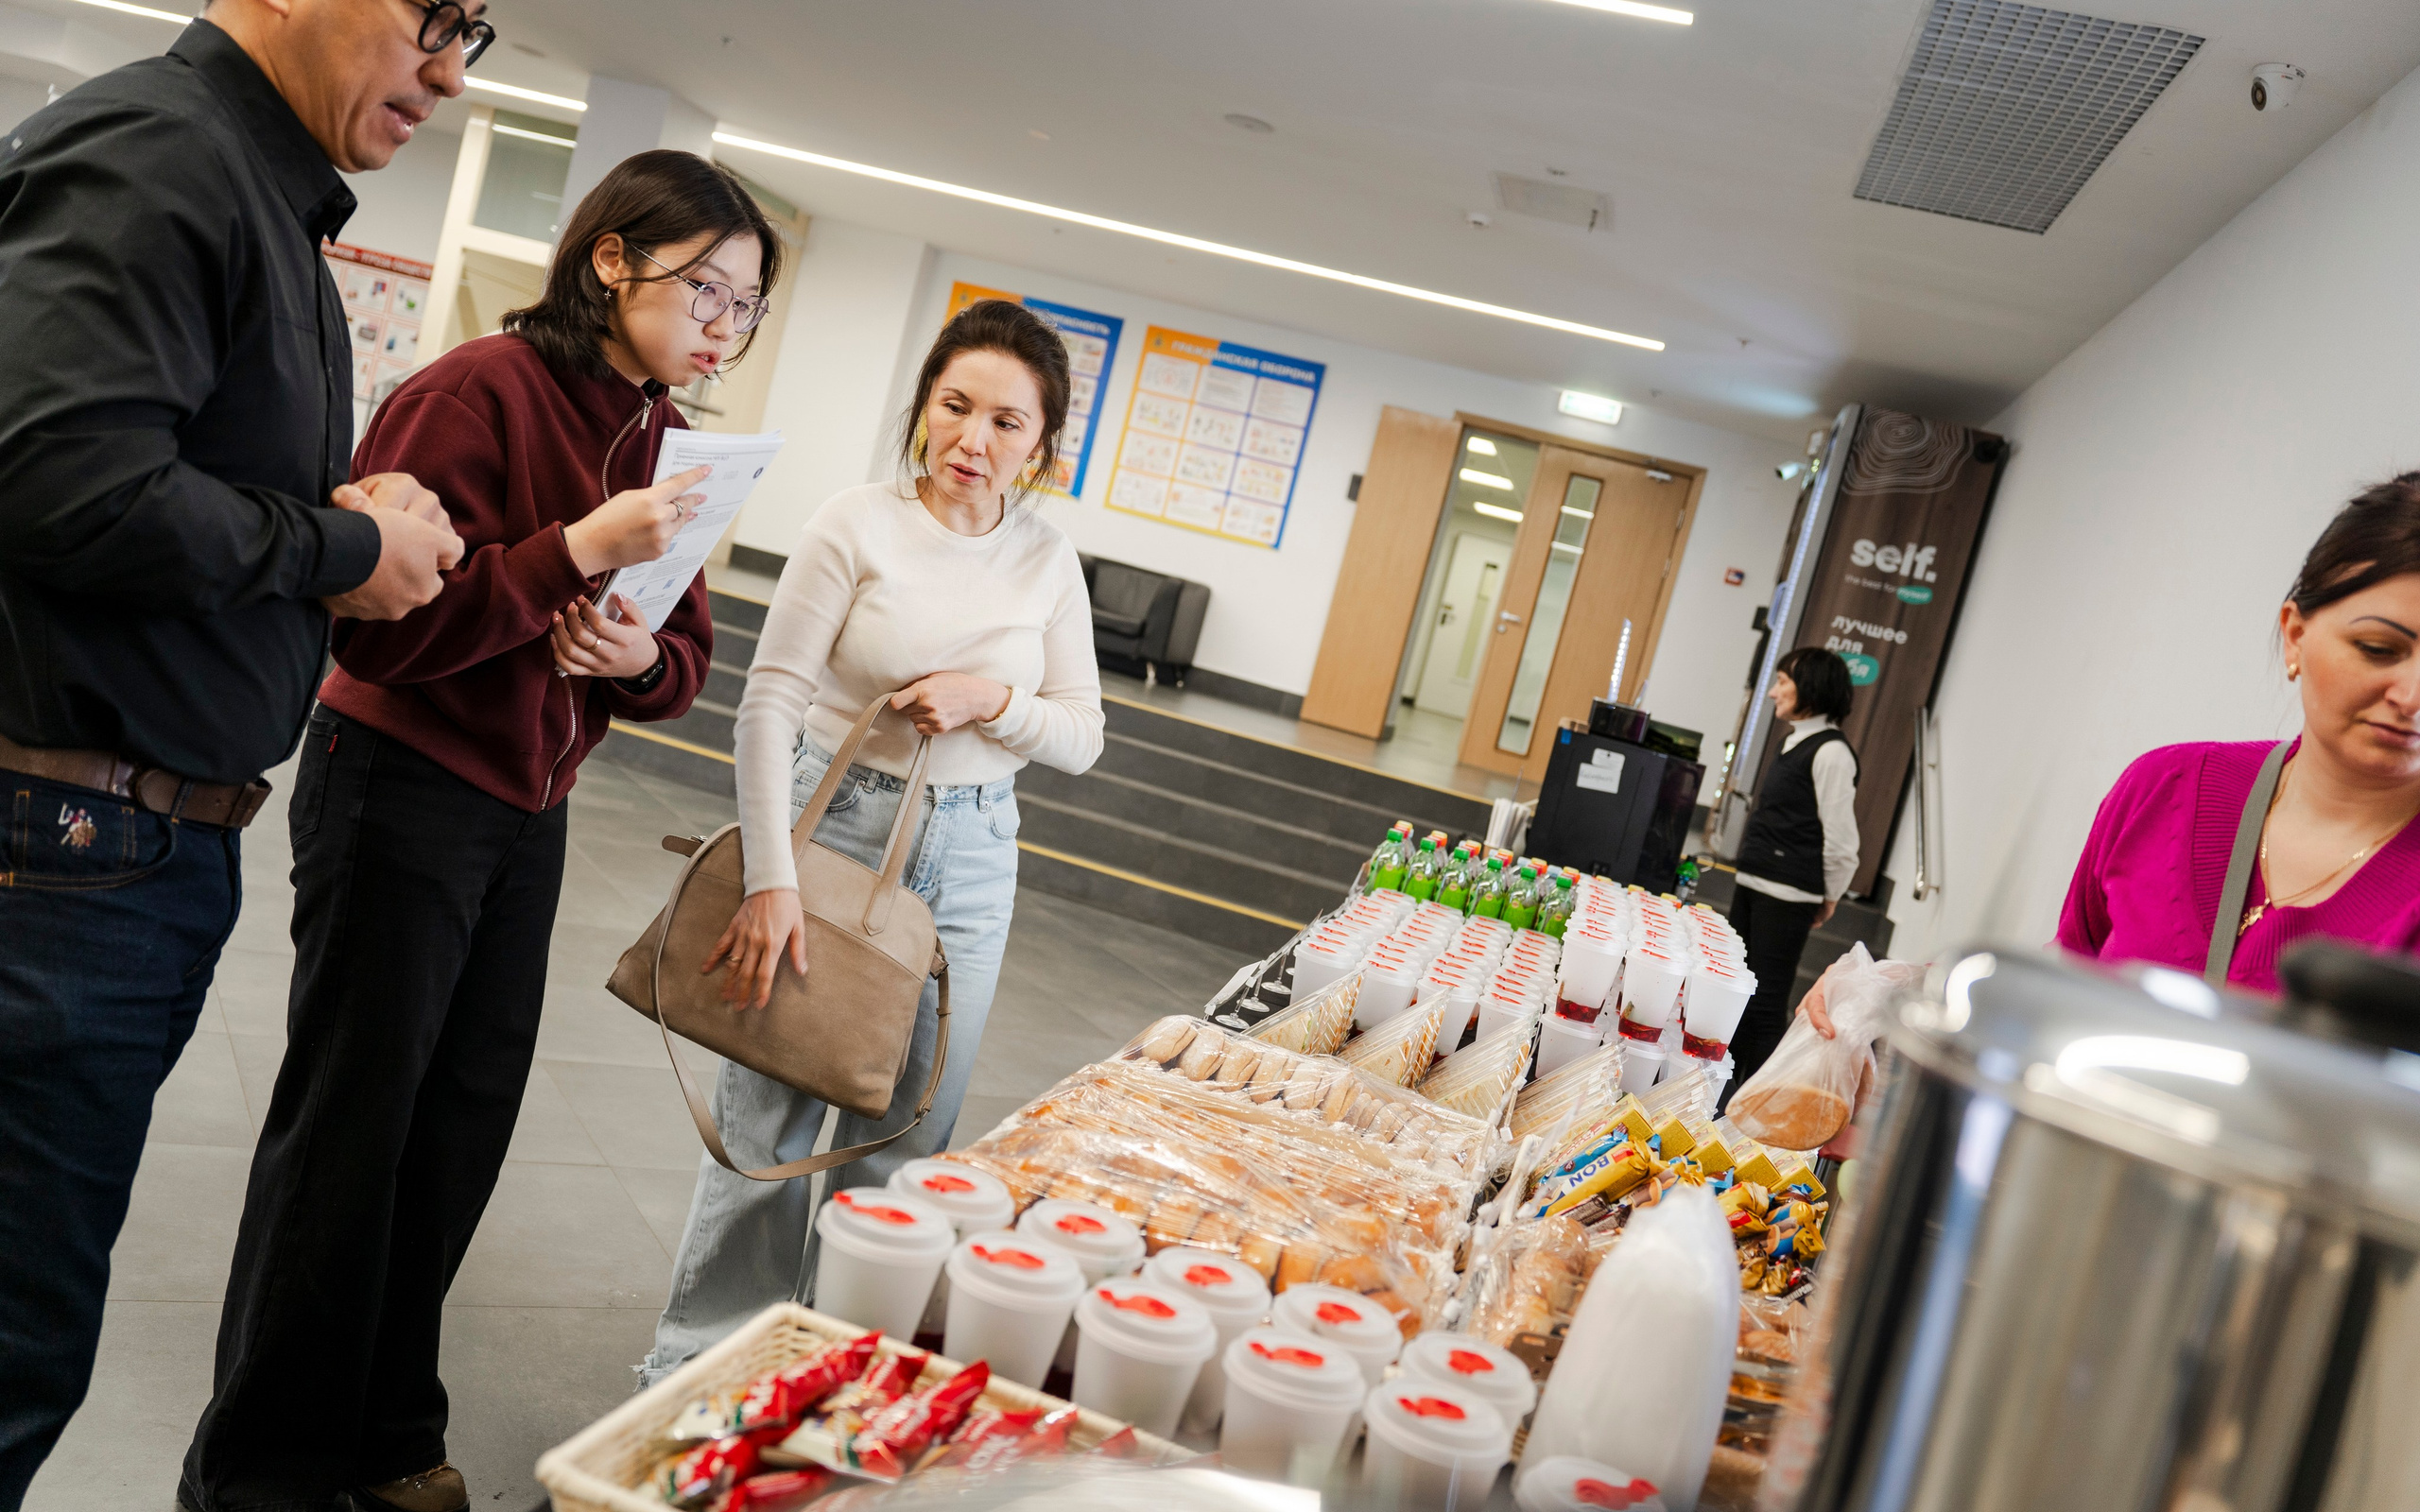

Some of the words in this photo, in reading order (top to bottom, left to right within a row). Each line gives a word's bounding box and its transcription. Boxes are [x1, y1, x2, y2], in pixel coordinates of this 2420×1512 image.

[1171, 340, 1258, 369] ГРАЖДАНСКАЯ
[1259, 360, 1317, 383] ОБОРОНА
[1850, 539, 1938, 583] self.
[1831, 615, 1908, 644] лучшее
[1824, 635, 1864, 655] для
[1846, 659, 1870, 679] бя
[1569, 1156, 1611, 1187] BON
